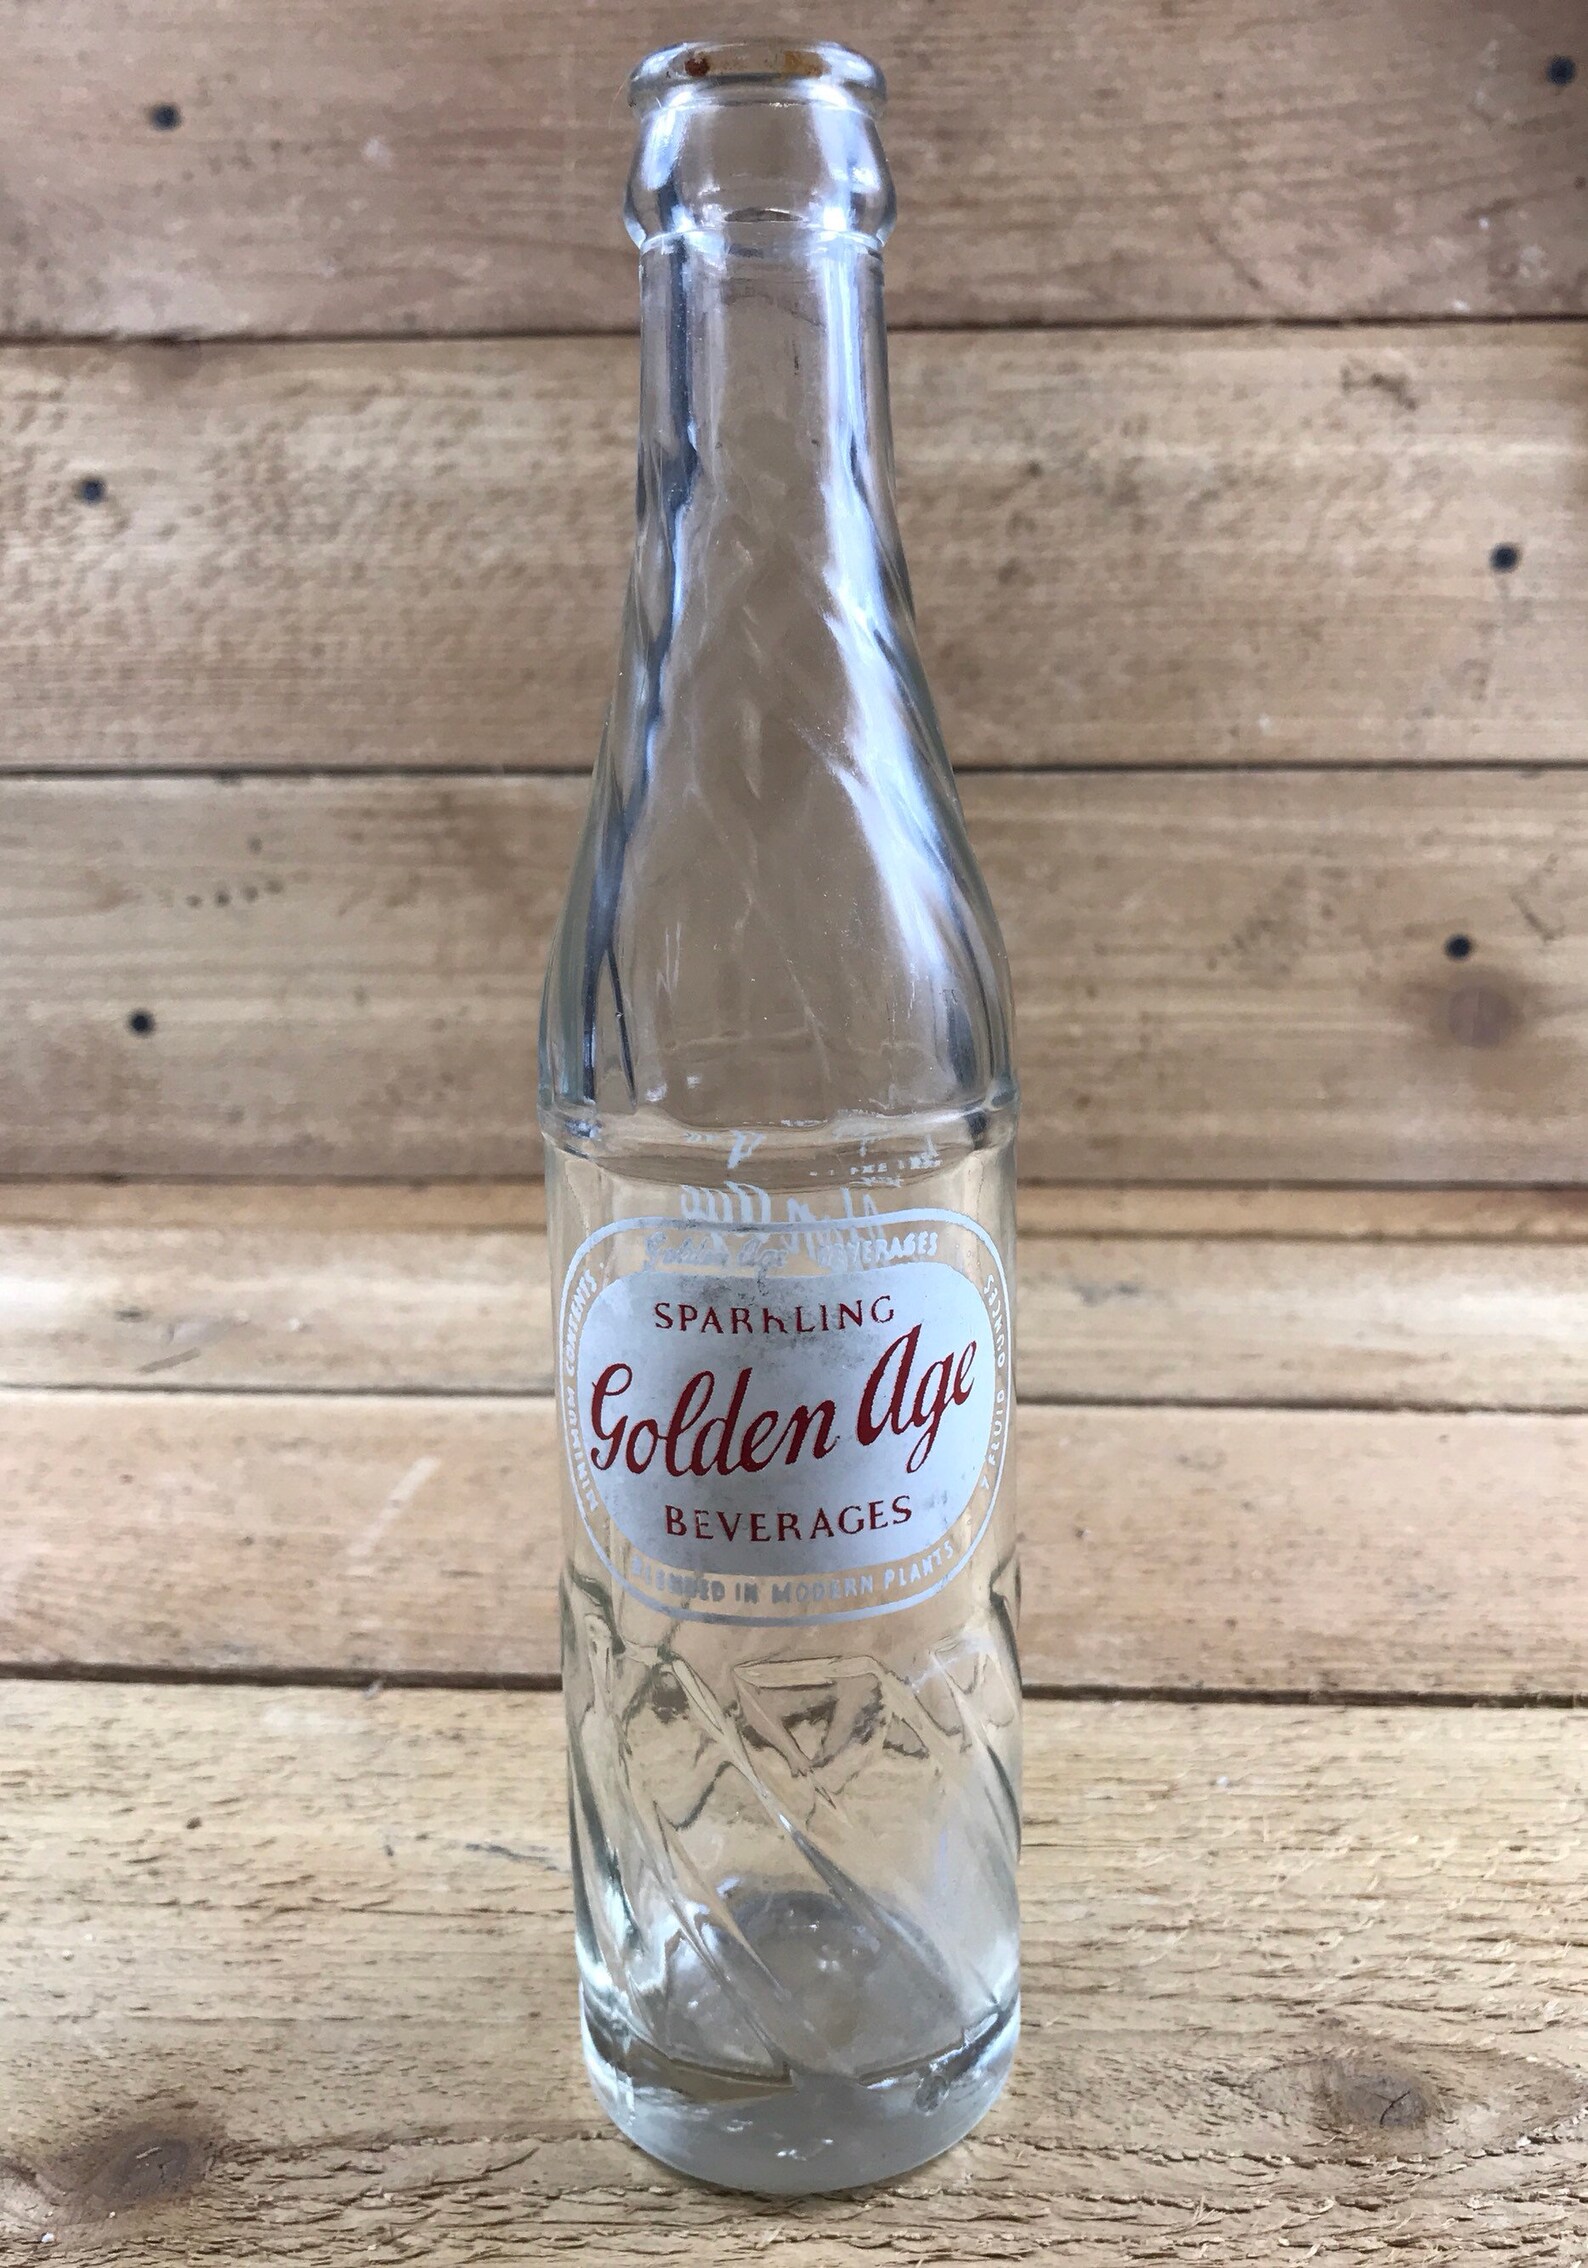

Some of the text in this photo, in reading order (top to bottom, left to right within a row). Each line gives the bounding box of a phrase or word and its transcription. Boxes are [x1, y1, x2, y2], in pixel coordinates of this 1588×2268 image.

[565, 1268, 597, 1376] CONTENTS
[654, 1295, 894, 1335] SPARKLING
[983, 1274, 1005, 1368] OUNCES
[590, 1323, 977, 1477] Golden Age
[664, 1494, 913, 1543] BEVERAGES
[735, 1582, 759, 1604] IN
[771, 1577, 873, 1604] MODERN
[883, 1540, 954, 1590] PLANTS
